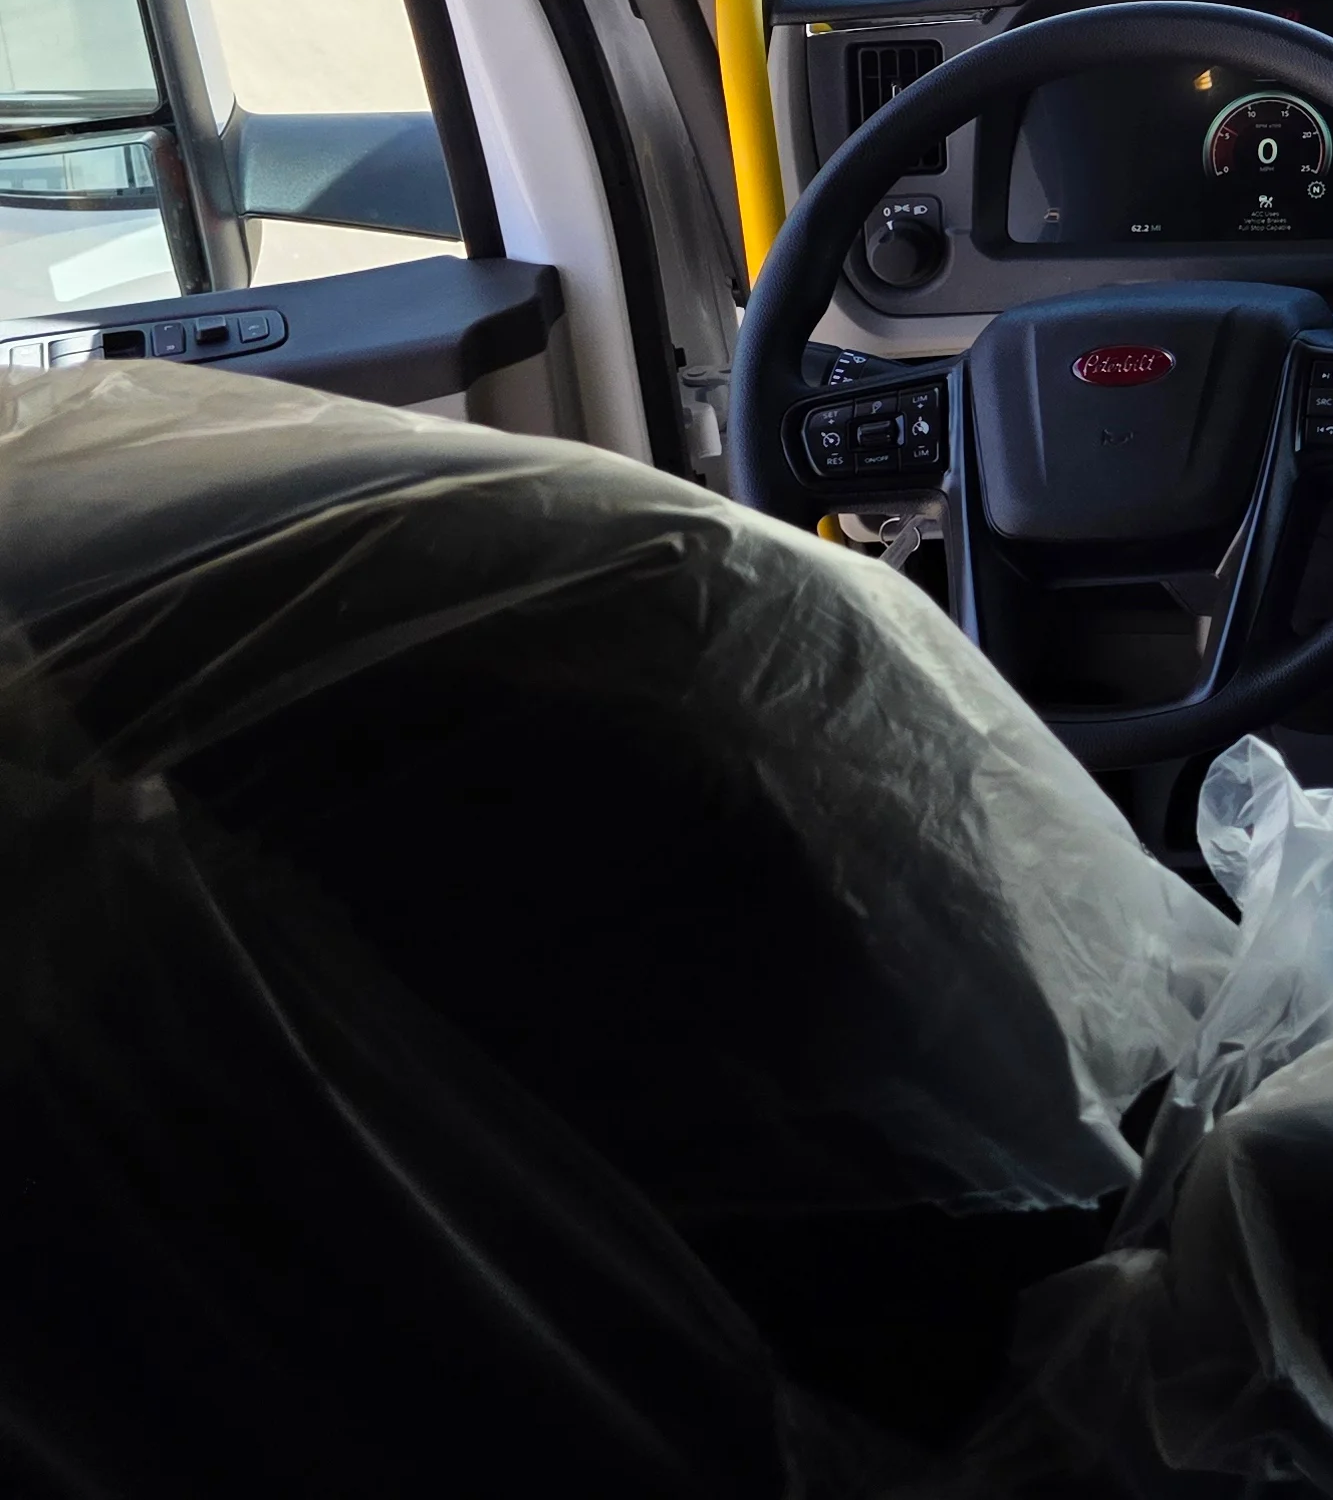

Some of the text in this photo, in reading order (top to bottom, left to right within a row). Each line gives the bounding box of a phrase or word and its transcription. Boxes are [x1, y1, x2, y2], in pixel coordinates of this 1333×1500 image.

[1302, 131, 1312, 139] 20
[1257, 137, 1278, 164] 0
[1312, 186, 1321, 194] N
[1131, 225, 1149, 233] 62.2
[1082, 354, 1155, 377] Peterbilt
[912, 394, 928, 404] LIM
[1315, 398, 1332, 406] SRC
[822, 410, 838, 419] SET
[913, 449, 930, 458] LIM
[826, 456, 844, 466] RES
